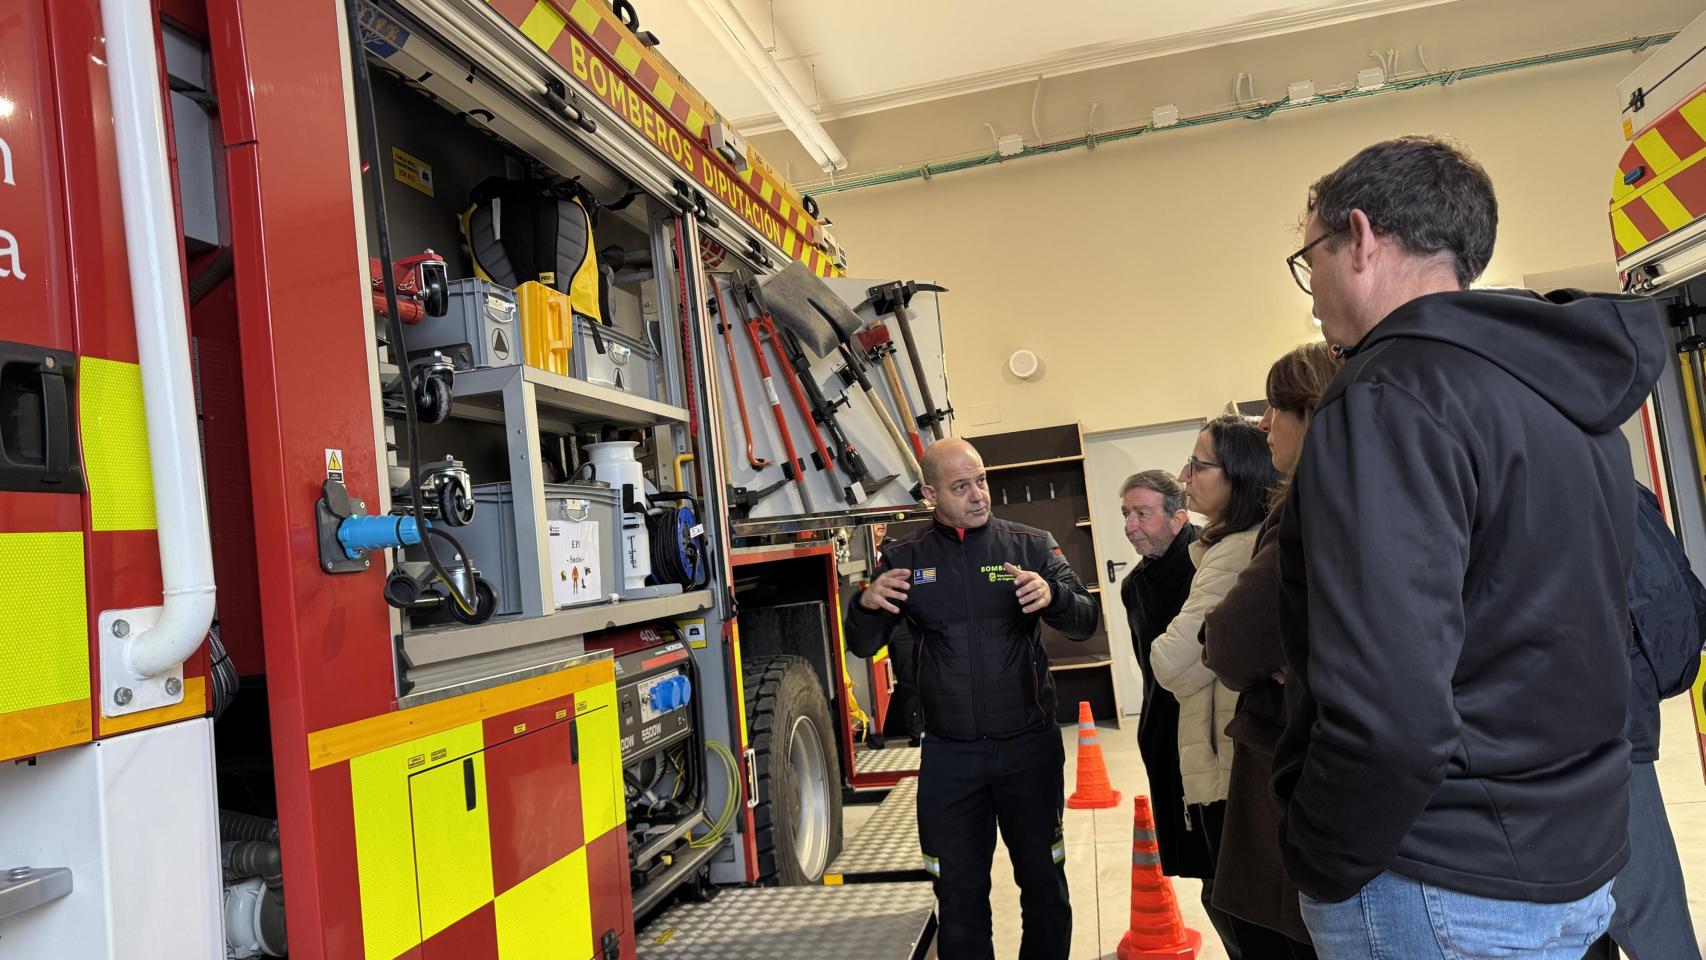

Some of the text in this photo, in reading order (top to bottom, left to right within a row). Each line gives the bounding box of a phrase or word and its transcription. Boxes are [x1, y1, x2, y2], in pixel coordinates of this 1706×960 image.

[570, 35, 694, 172] BOMBEROS
[702, 155, 781, 246] DIPUTACIÓN
[571, 540, 581, 549] EPI
[641, 722, 662, 742] 5500W
